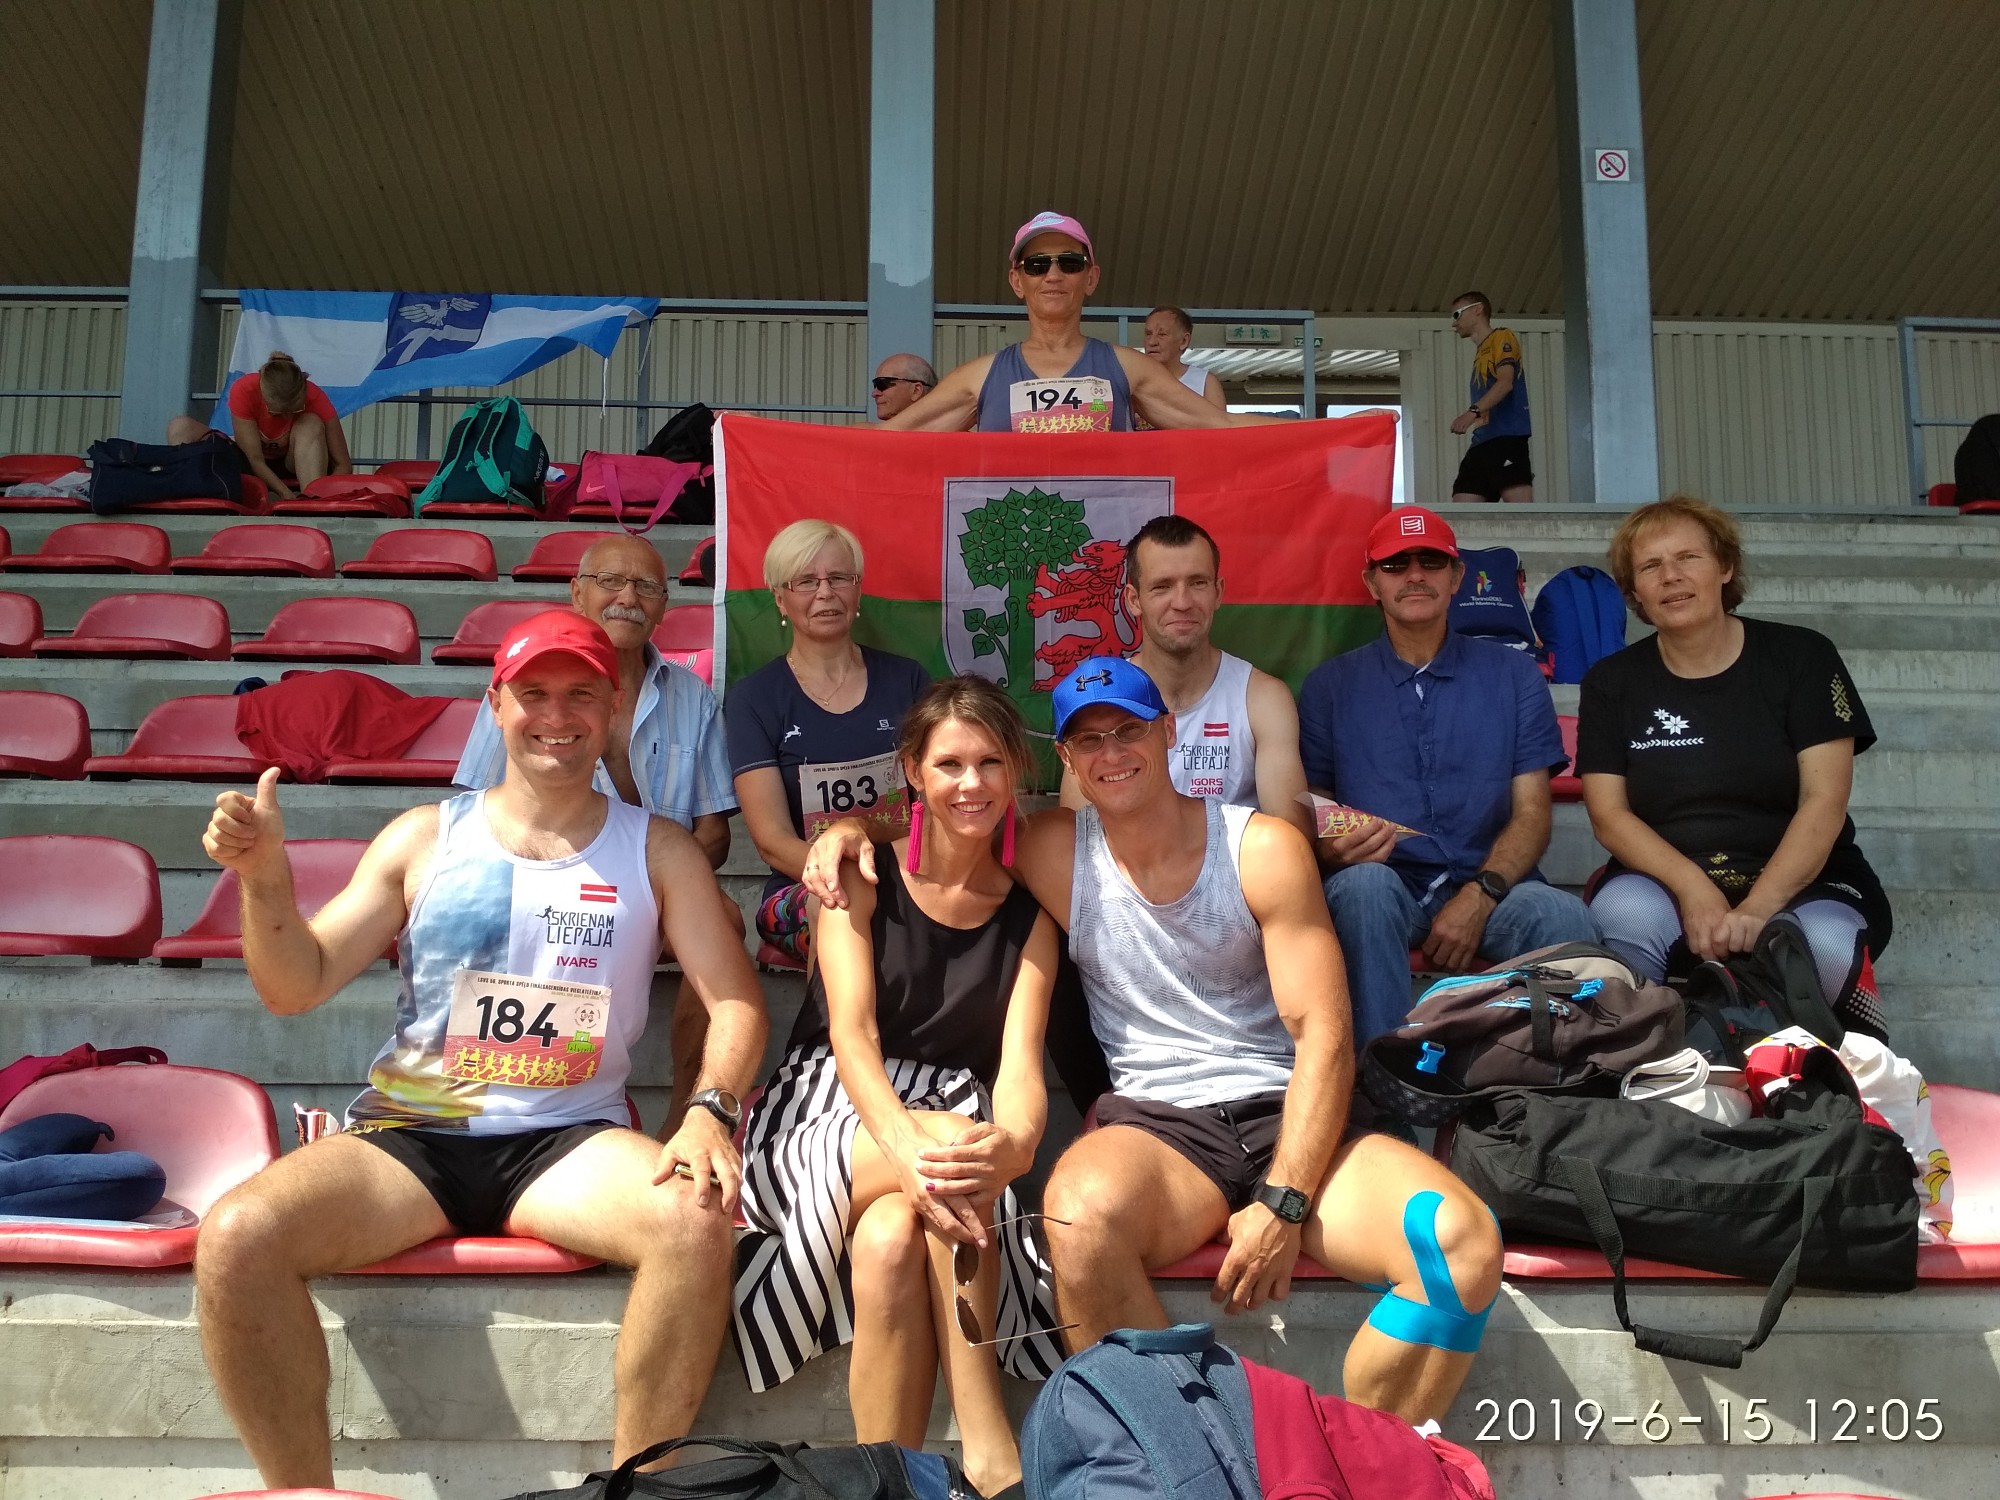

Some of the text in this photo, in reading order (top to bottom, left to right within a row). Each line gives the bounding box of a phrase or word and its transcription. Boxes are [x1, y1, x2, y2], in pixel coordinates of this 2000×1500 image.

[1026, 387, 1082, 412] 194
[1190, 787, 1223, 795] SENKO
[1191, 778, 1223, 786] IGORS
[817, 775, 878, 813] 183
[551, 911, 615, 930] SKRIENAM
[556, 955, 598, 968] IVARS
[476, 995, 559, 1048] 184
